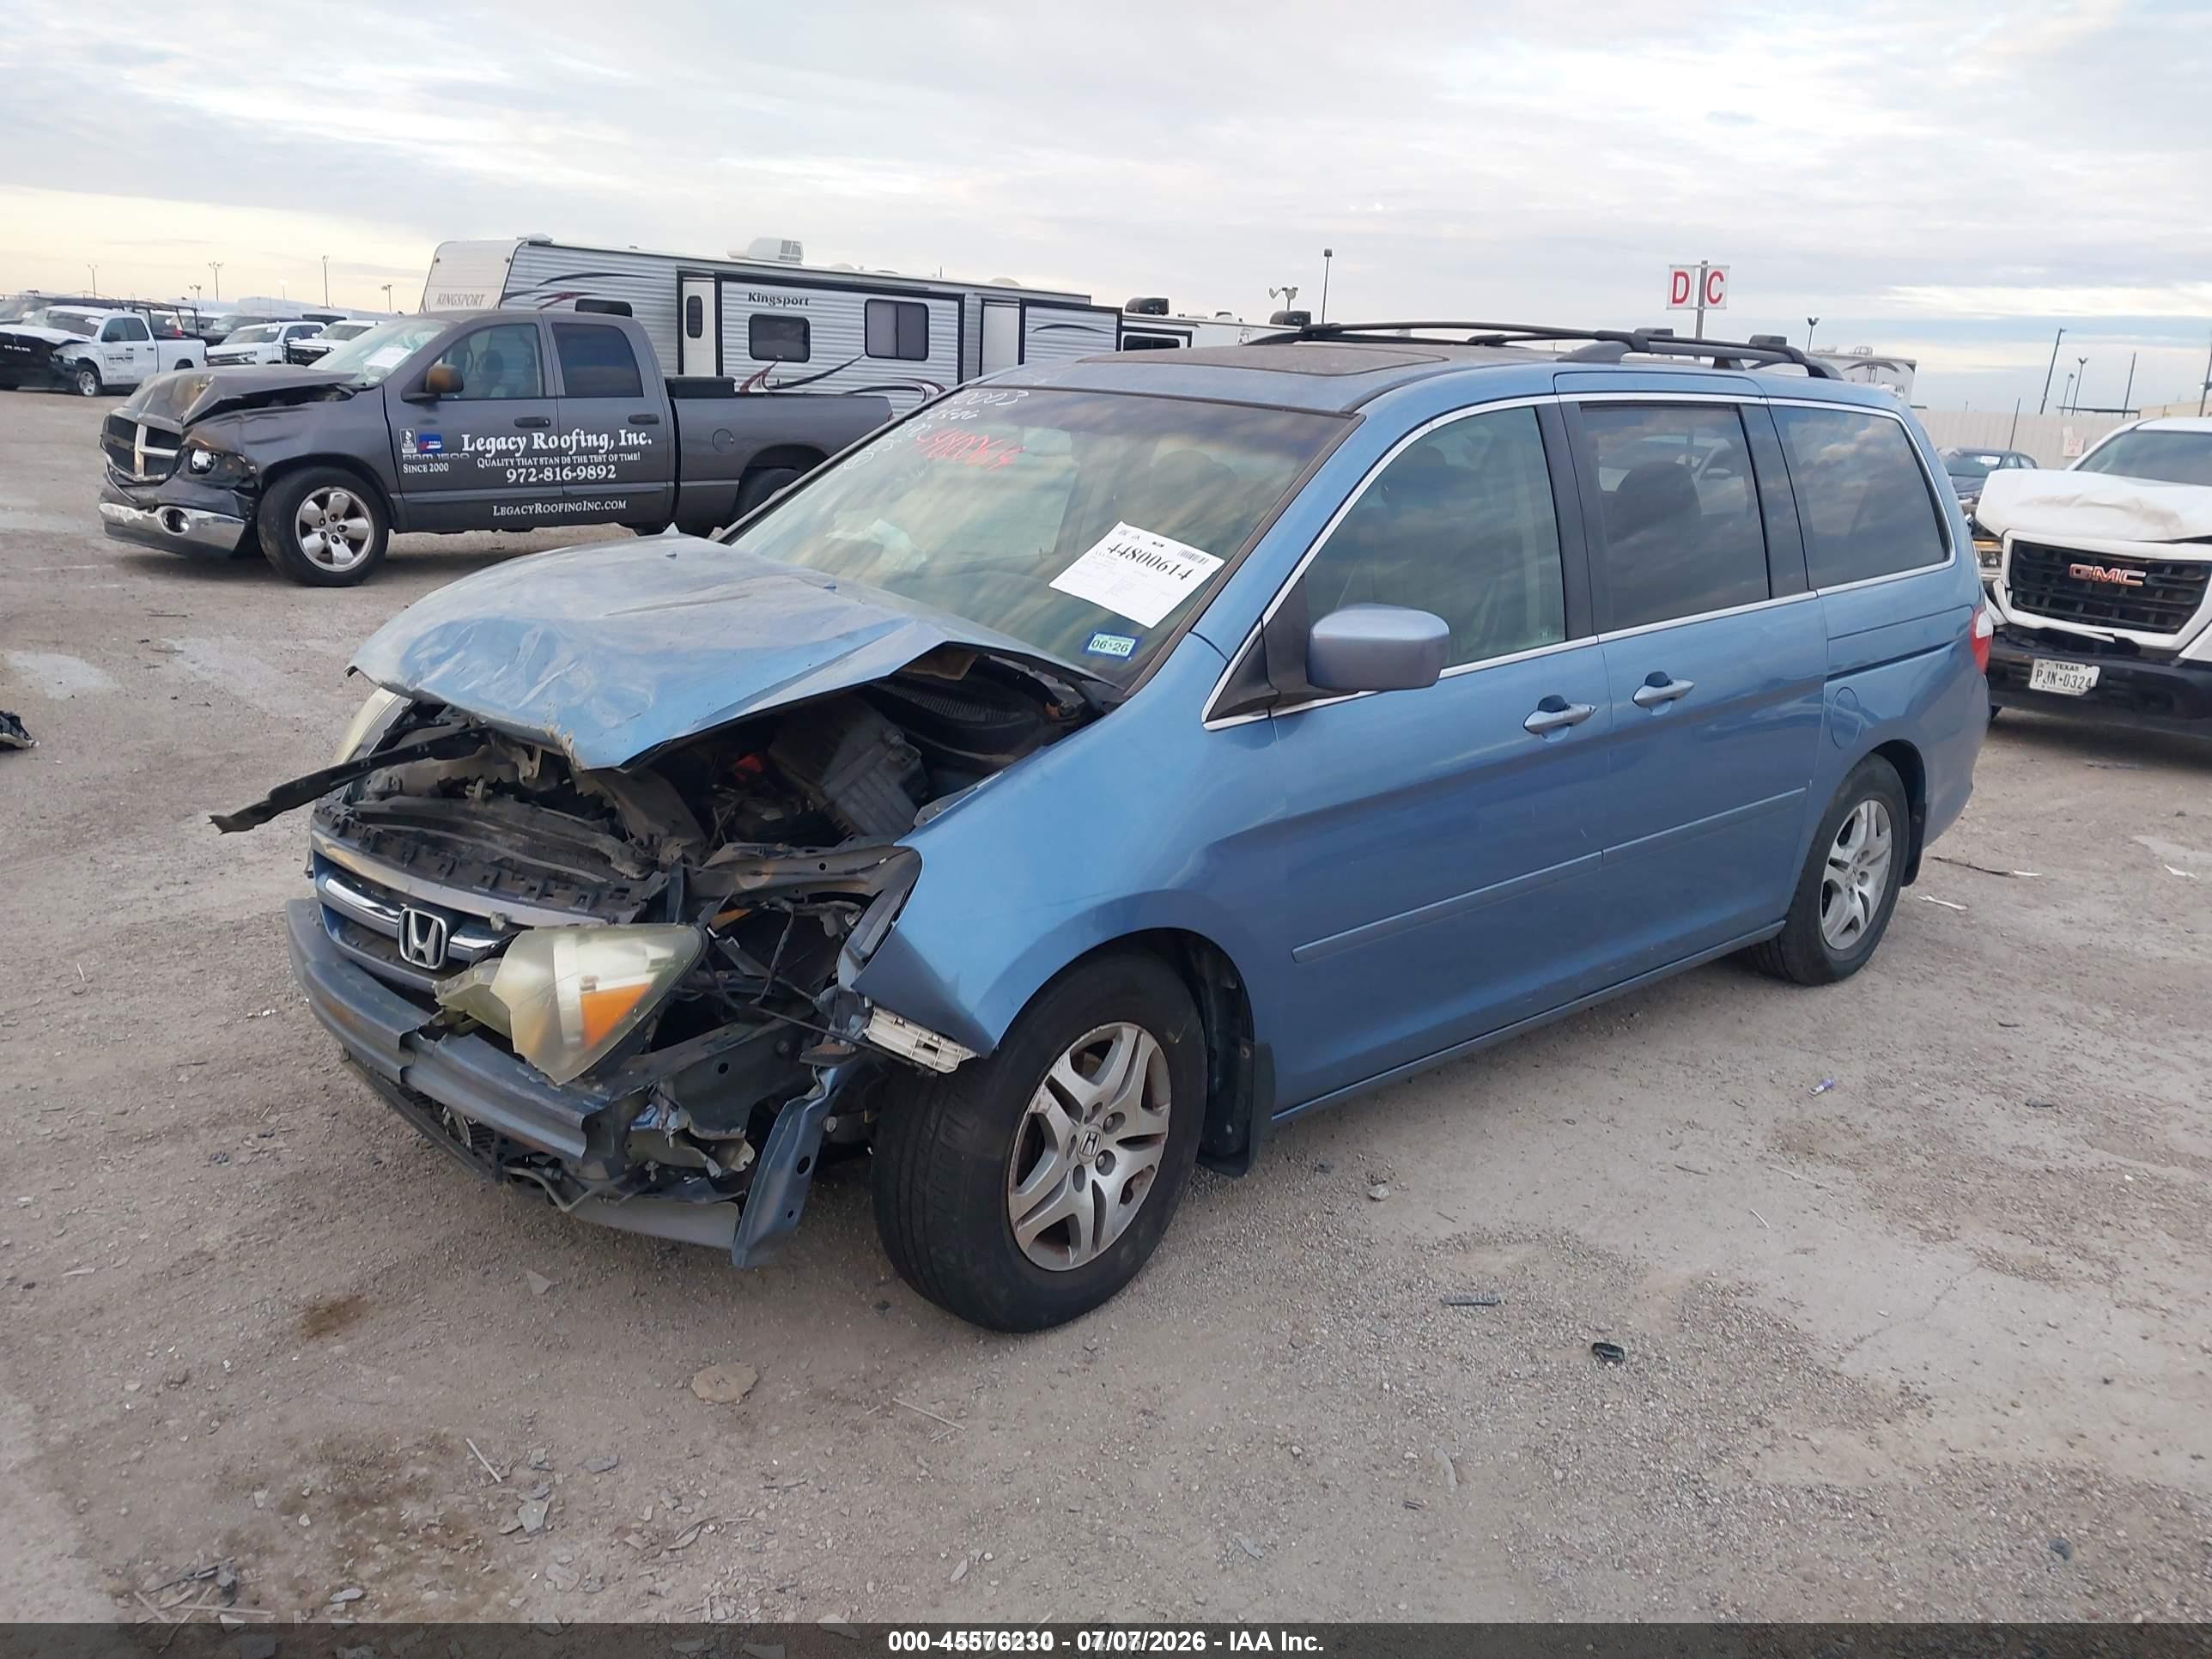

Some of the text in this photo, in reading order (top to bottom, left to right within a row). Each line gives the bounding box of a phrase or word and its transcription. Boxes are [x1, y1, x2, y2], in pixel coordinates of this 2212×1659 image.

[1671, 270, 1690, 305] D
[1706, 270, 1724, 305] C
[437, 293, 486, 307] KINGSPORT
[748, 291, 809, 307] Kingsport
[461, 428, 653, 457] Legacy Roofing, Inc.
[403, 462, 449, 473] SINCE 2000
[477, 457, 515, 469] QUALITY
[515, 456, 538, 466] THAT
[572, 454, 588, 464] THE
[588, 453, 607, 463] TEST
[618, 451, 641, 461] TIME!
[506, 465, 617, 483] 972-816-9892
[493, 500, 627, 517] LEGACYROOFINGINC.COM
[1107, 542, 1194, 580] 44800614
[2069, 563, 2147, 586] GMC
[1091, 639, 1108, 649] 06
[1112, 642, 1129, 653] 26
[2055, 663, 2080, 672] TEXAS
